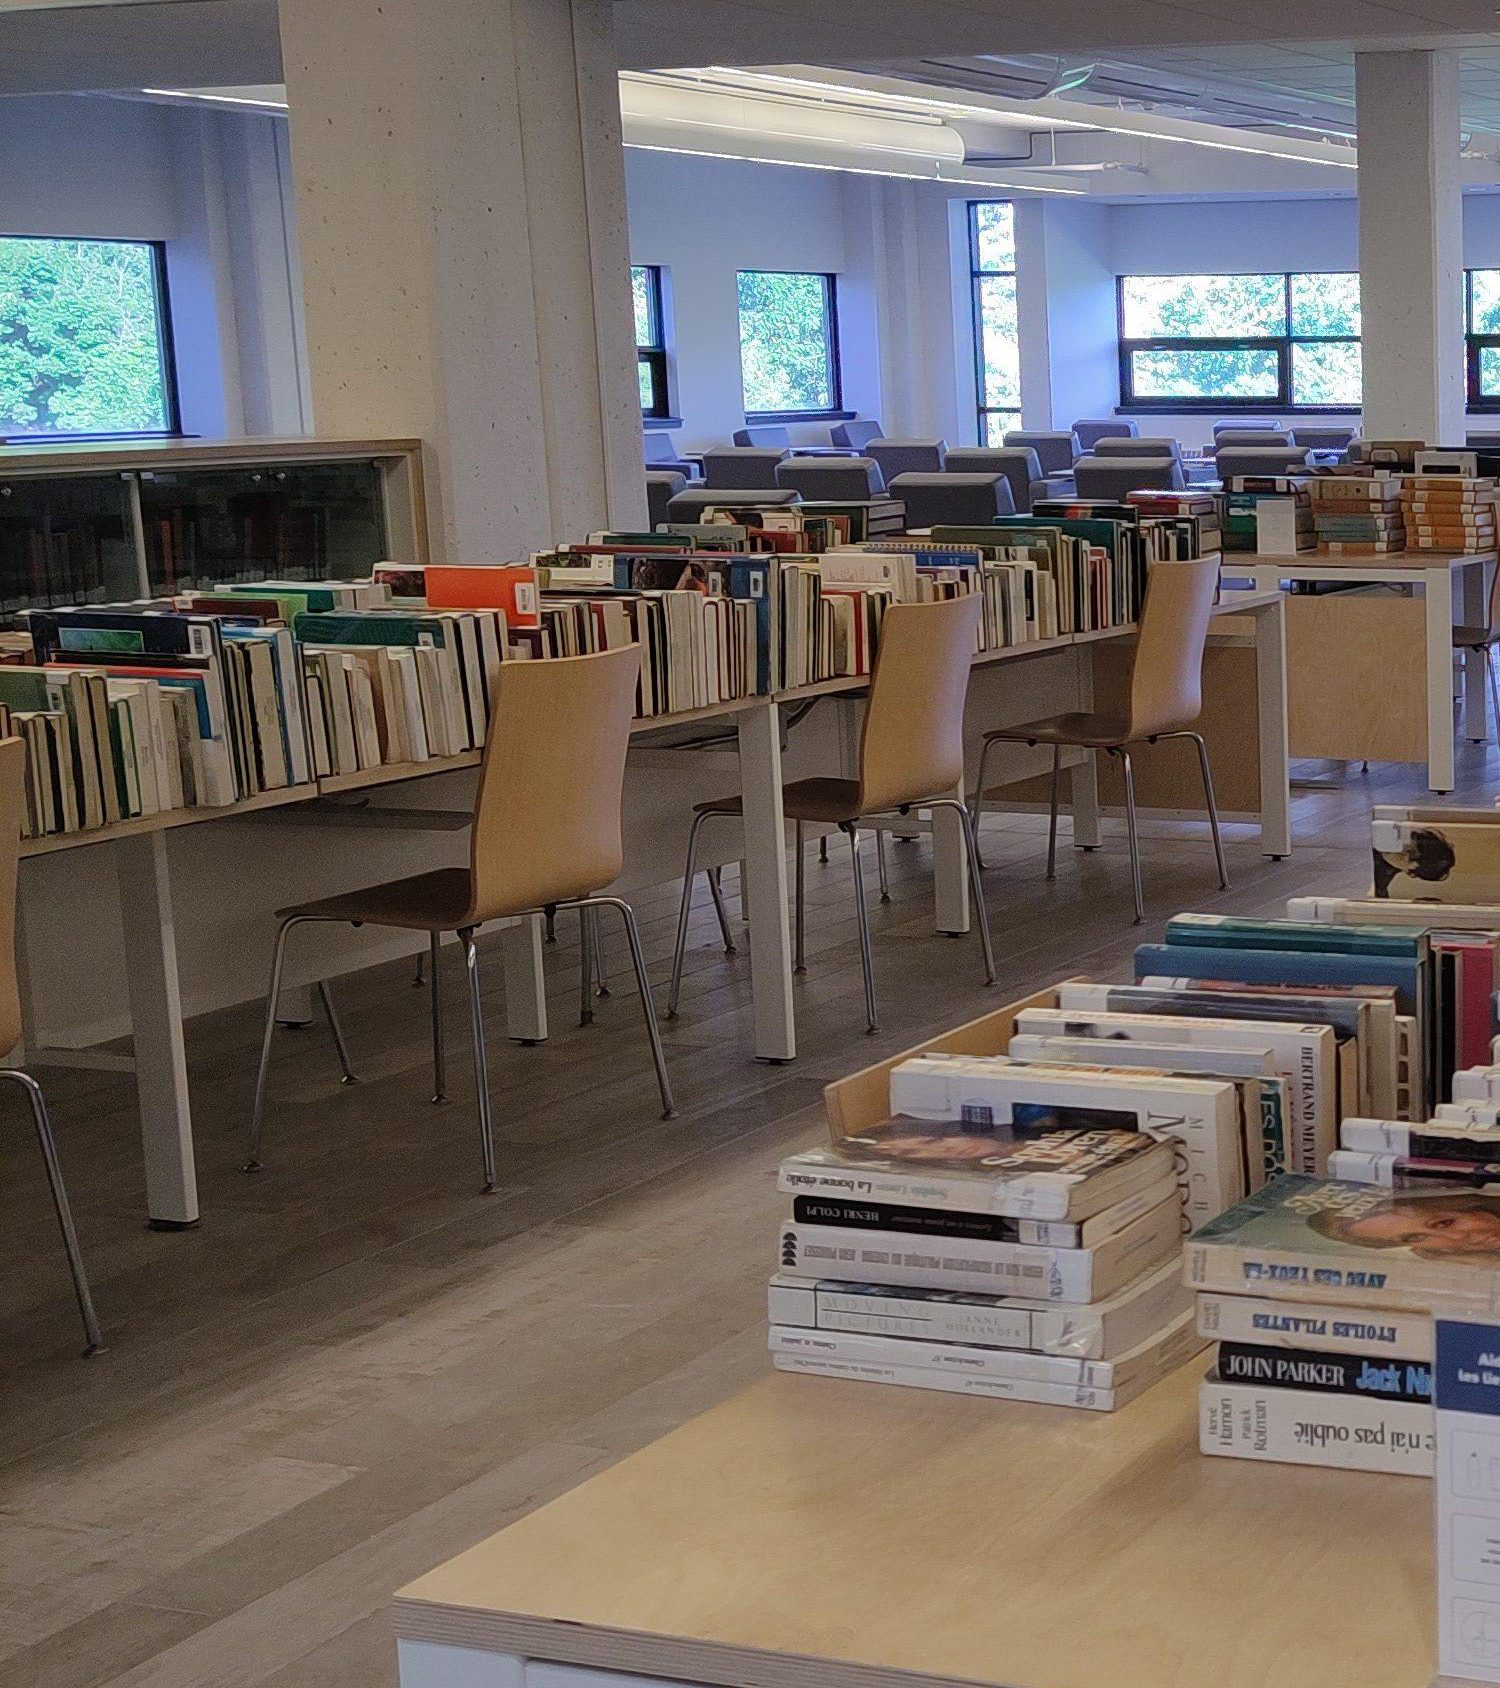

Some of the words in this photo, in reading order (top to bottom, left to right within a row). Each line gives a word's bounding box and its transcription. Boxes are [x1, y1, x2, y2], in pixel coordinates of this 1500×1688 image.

[1301, 1047, 1315, 1121] BERTRAND
[1302, 1125, 1316, 1174] MEYER
[819, 1177, 855, 1192] bonne
[857, 1181, 872, 1193] La
[806, 1205, 840, 1217] COLPI
[844, 1208, 879, 1221] HENRI
[1226, 1355, 1273, 1378] JOHN
[1276, 1360, 1346, 1387] PARKER
[1356, 1361, 1402, 1392] Jack
[1219, 1398, 1233, 1447] Hamon
[1253, 1400, 1267, 1451] Rotman
[1294, 1422, 1349, 1448] oublié
[1354, 1422, 1385, 1445] pas
[1390, 1434, 1420, 1454] n'ai
